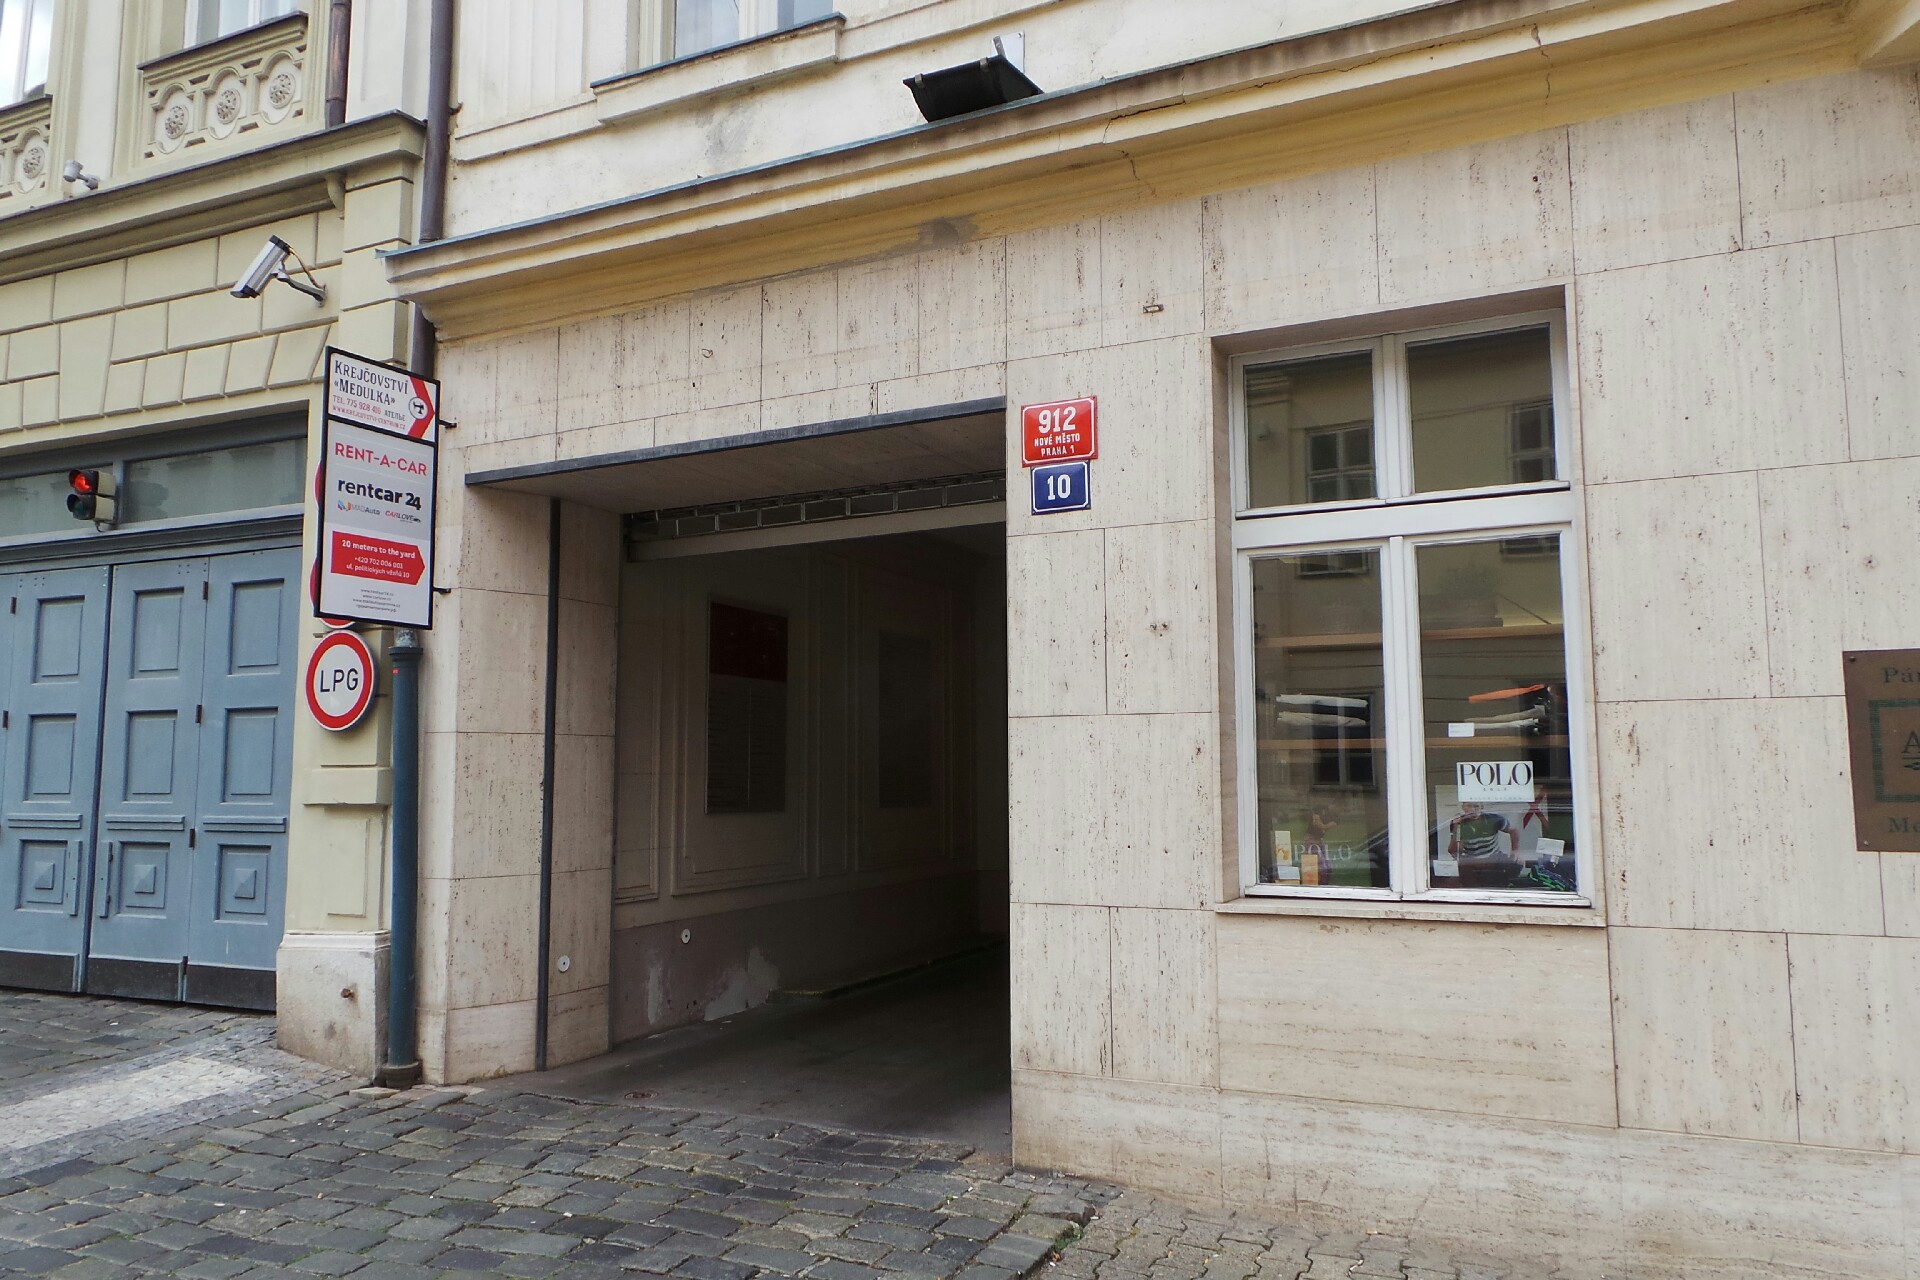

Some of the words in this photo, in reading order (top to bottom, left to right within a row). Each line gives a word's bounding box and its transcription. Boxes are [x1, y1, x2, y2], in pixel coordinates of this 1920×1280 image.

[334, 360, 409, 394] KREJČOVSTVÍ
[347, 398, 357, 408] 775
[359, 402, 370, 411] 928
[1038, 406, 1077, 434] 912
[1034, 434, 1053, 447] NOVÉ
[1055, 432, 1081, 443] MĚSTO
[1041, 446, 1067, 457] PRAHA
[1070, 445, 1075, 453] 1
[335, 442, 428, 476] RENT-A-CAR
[338, 479, 403, 504] rentcar
[405, 492, 422, 511] 24
[1047, 474, 1071, 501] 10
[342, 540, 351, 548] 20
[353, 543, 378, 552] meters
[388, 548, 399, 556] the
[400, 551, 416, 559] yard
[320, 668, 358, 692] LPG
[1883, 665, 1920, 684] Pá
[1460, 763, 1532, 786] POLO
[1293, 843, 1352, 861] POLO
